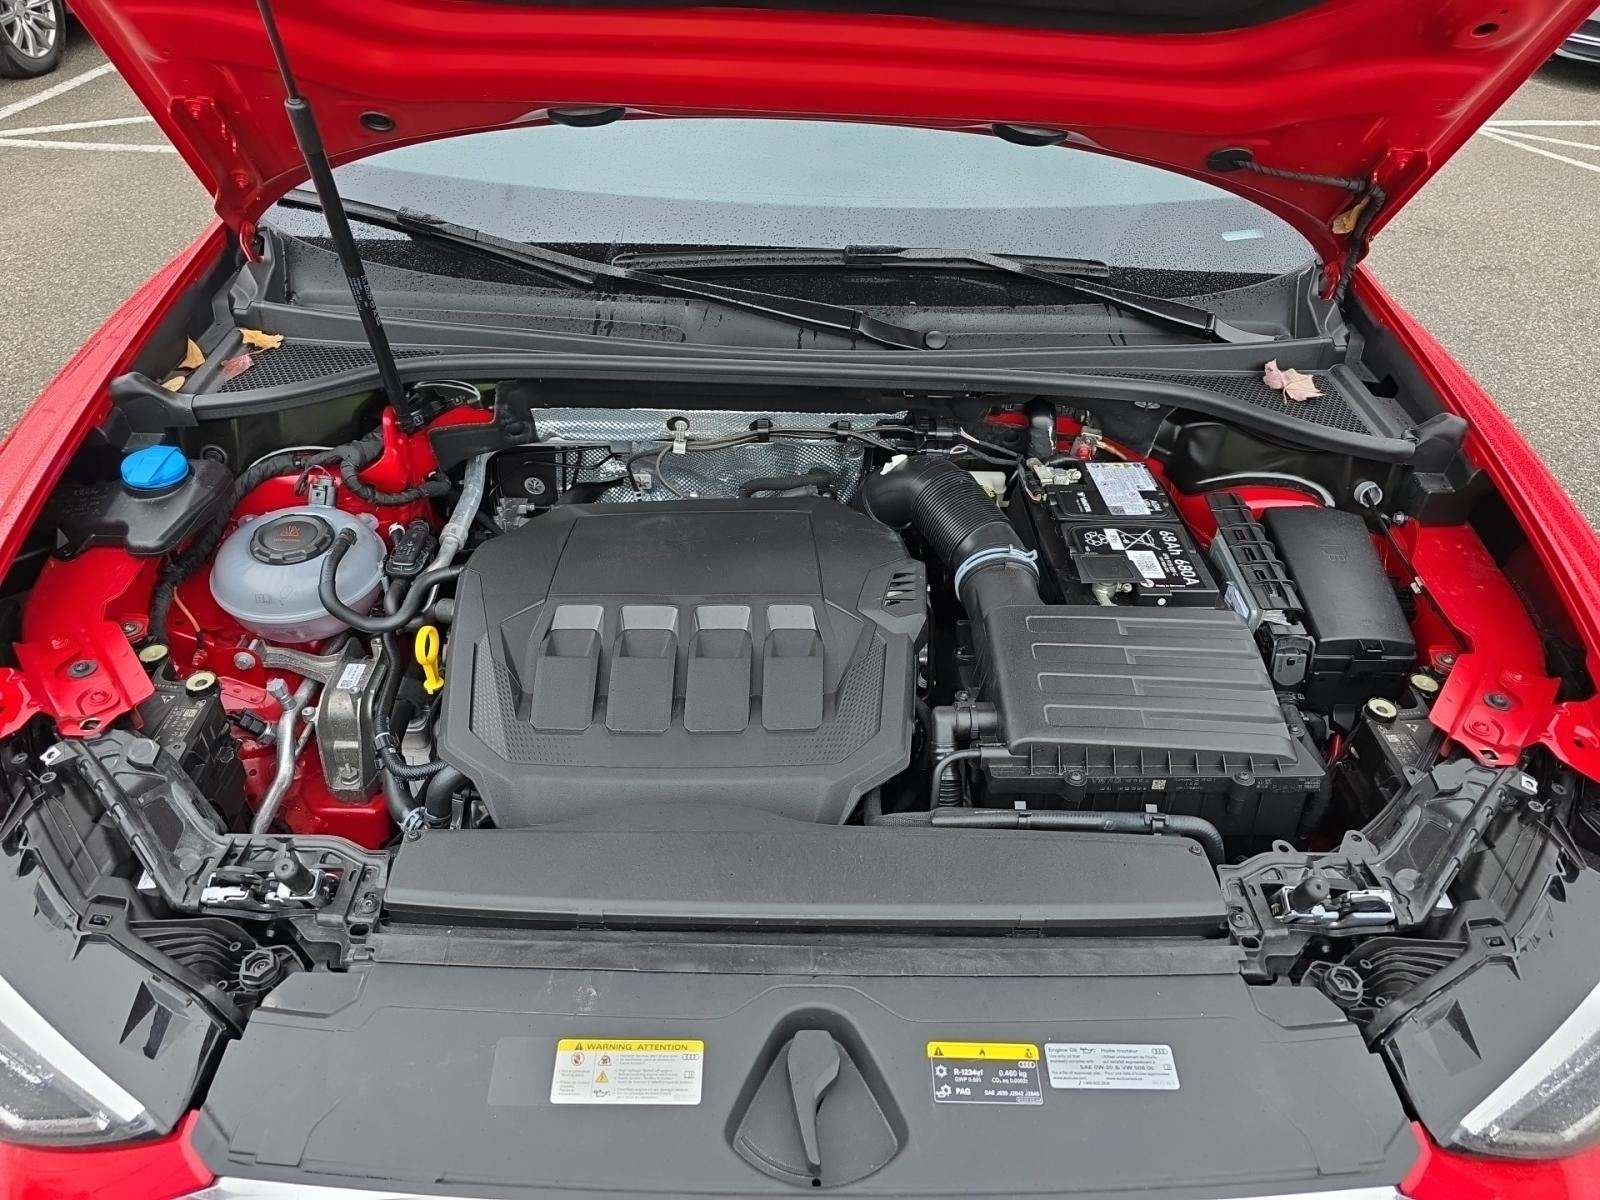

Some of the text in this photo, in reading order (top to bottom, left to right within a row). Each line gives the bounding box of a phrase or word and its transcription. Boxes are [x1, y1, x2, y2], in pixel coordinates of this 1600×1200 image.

[1159, 530, 1184, 555] 68Ah
[1174, 559, 1200, 586] 680A
[586, 1043, 689, 1051] WARNING ATTENTION
[953, 1067, 984, 1077] R-1234yf
[1018, 1070, 1028, 1078] kg
[955, 1087, 972, 1096] PAG
